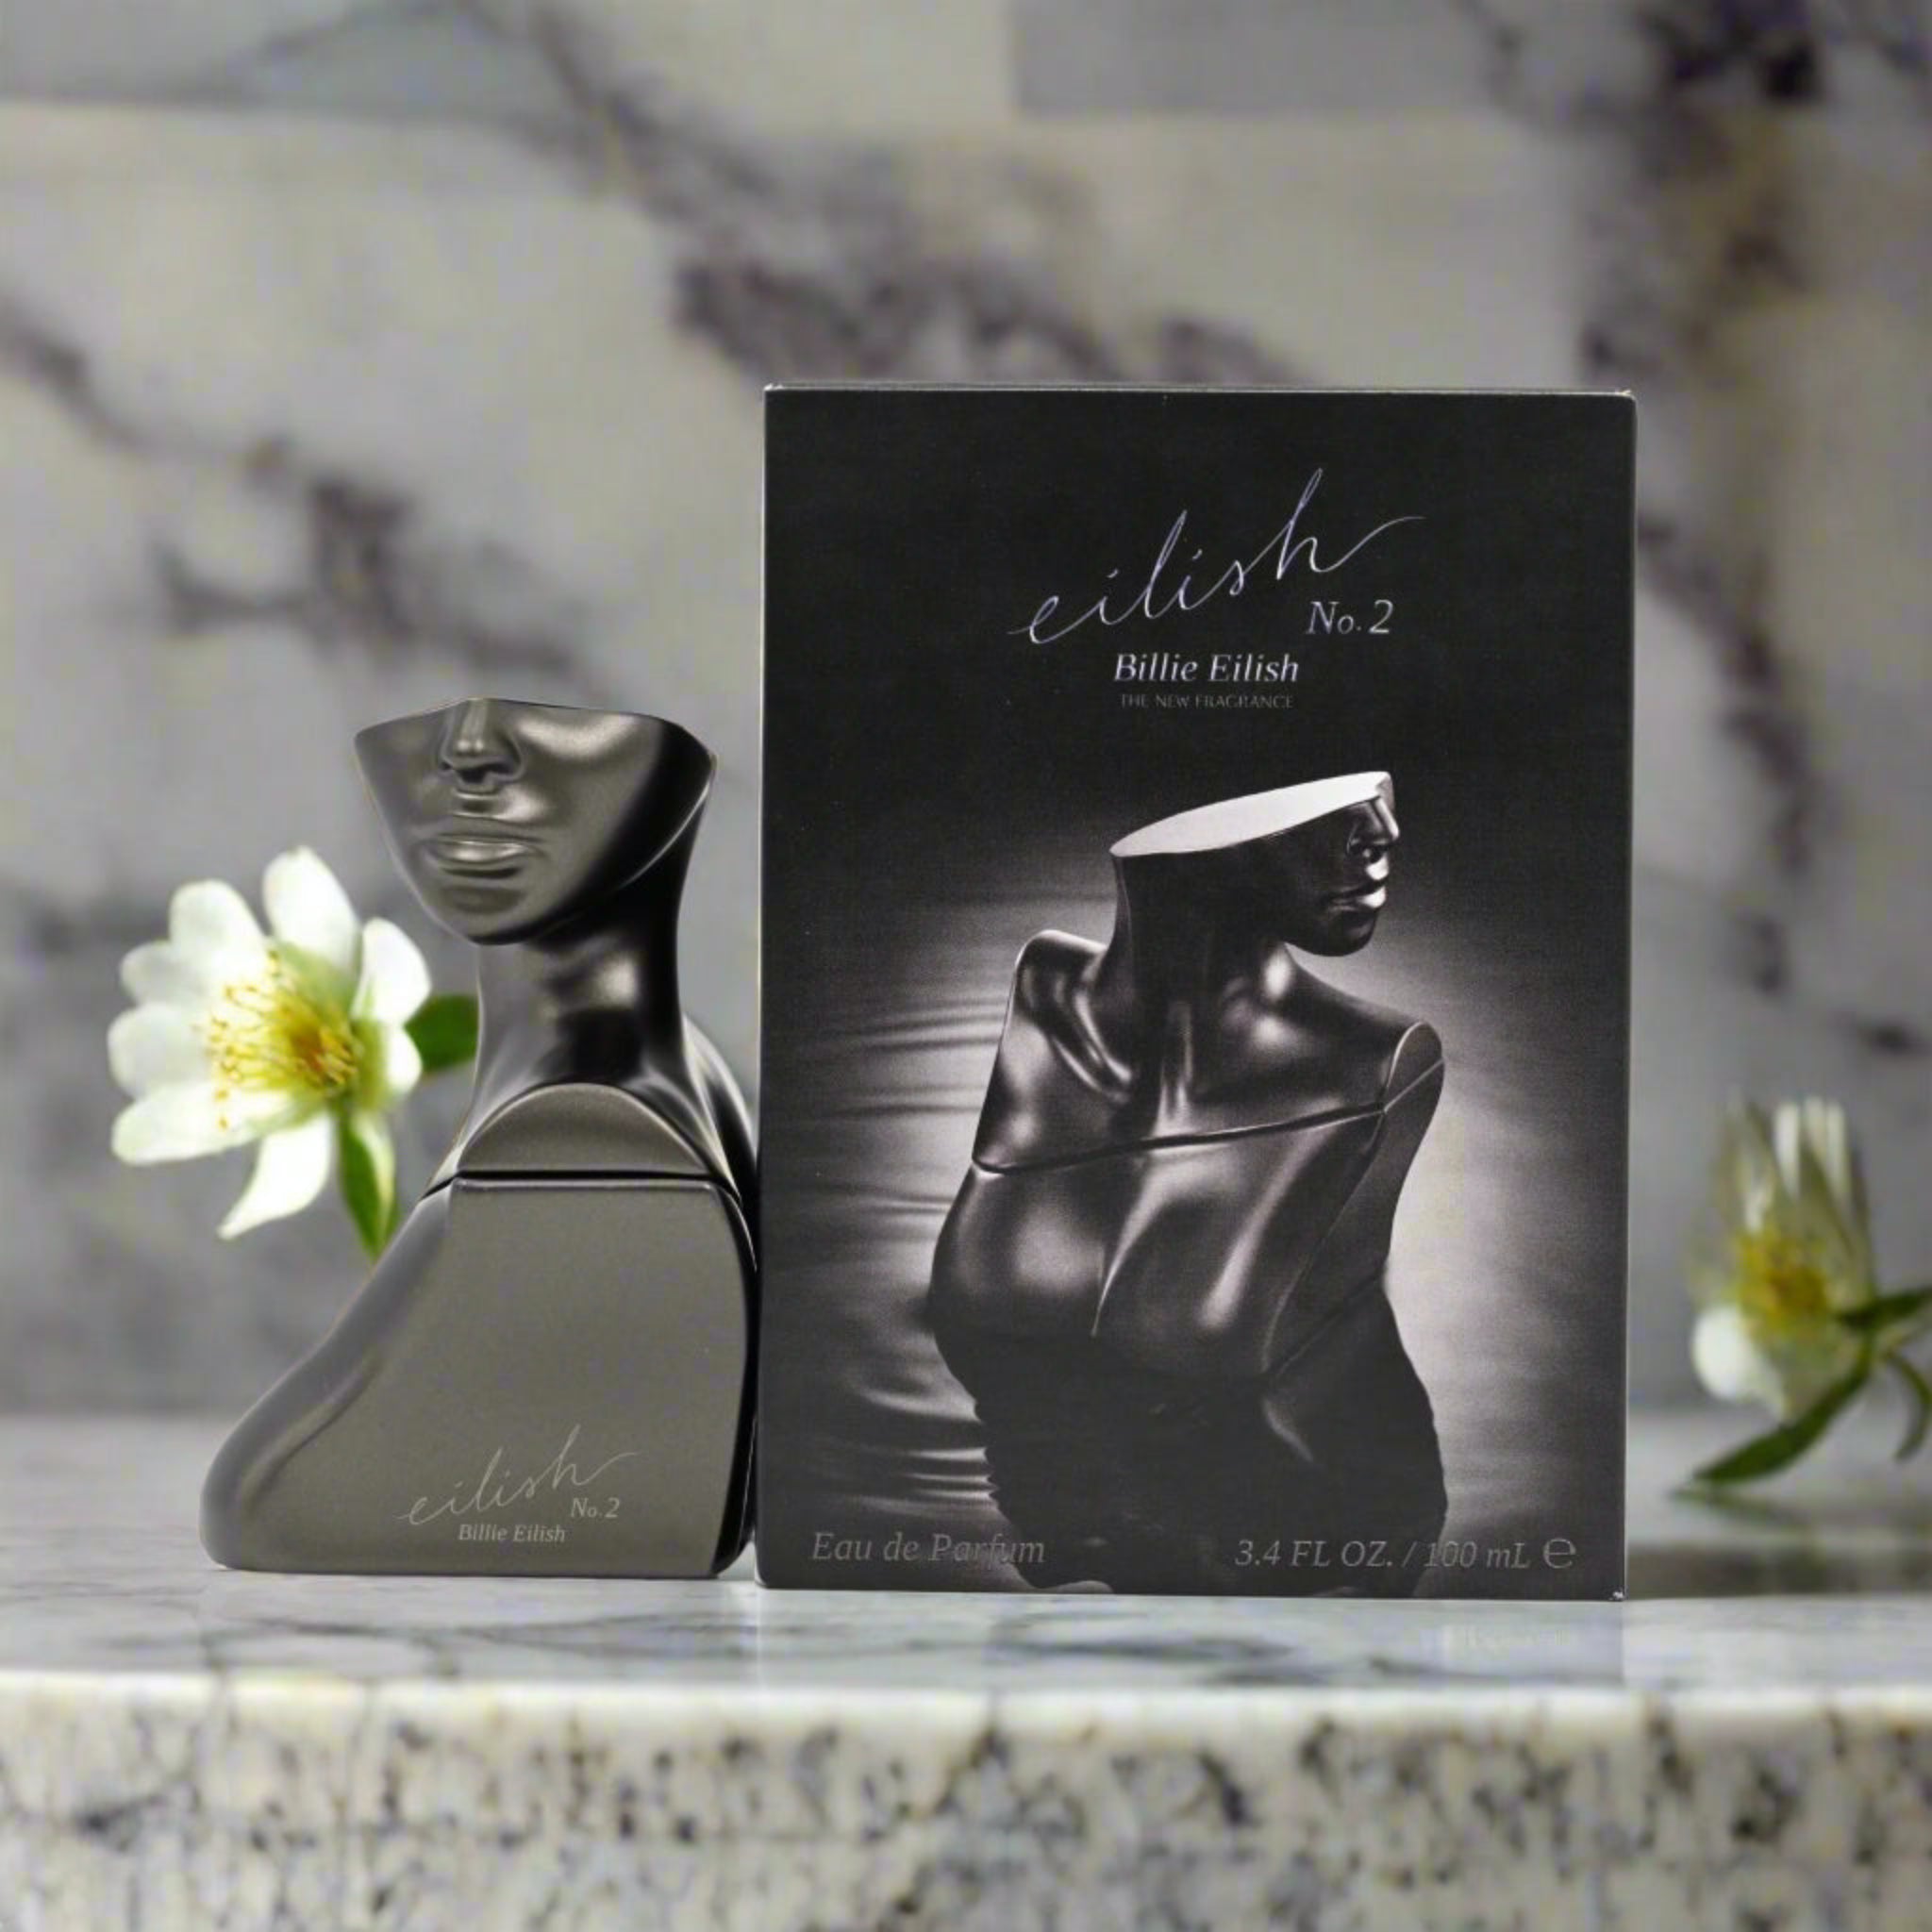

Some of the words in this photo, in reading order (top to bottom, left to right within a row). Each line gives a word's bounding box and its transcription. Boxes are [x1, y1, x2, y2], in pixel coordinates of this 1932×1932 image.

[1008, 468, 1425, 644] eilish
[1113, 653, 1198, 682] Billie
[1208, 653, 1300, 683] Eilish
[1121, 693, 1148, 708] THE
[1155, 693, 1190, 708] NEW
[1194, 693, 1294, 709] FRAGRANCE
[394, 1424, 638, 1525] eilish
[458, 1524, 508, 1541] Billie
[512, 1524, 567, 1543] Eilish
[811, 1531, 873, 1561] Eau
[883, 1531, 919, 1562] de
[927, 1533, 1046, 1566] Parfum
[1234, 1539, 1282, 1567] 3.4
[1289, 1540, 1331, 1568] FL
[1341, 1541, 1394, 1569] OZ.
[1423, 1541, 1478, 1569] 100
[1485, 1541, 1531, 1570] mL
